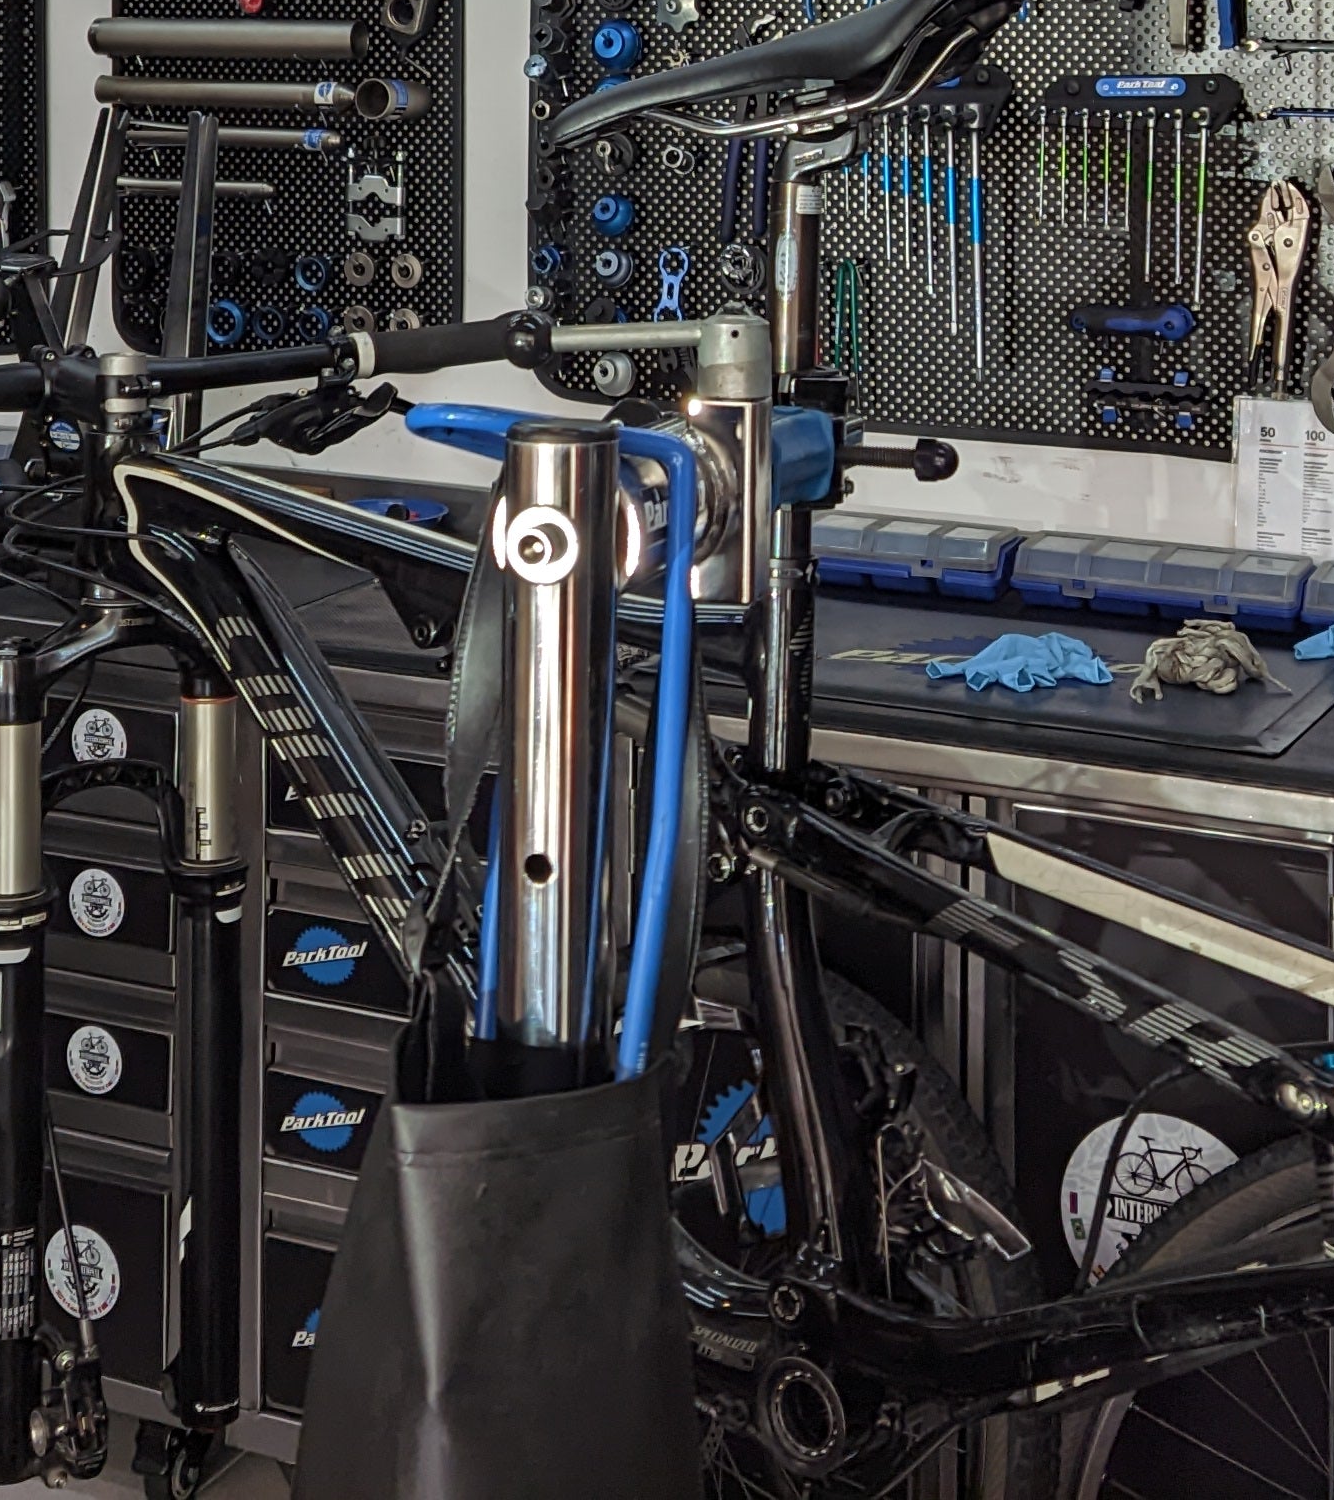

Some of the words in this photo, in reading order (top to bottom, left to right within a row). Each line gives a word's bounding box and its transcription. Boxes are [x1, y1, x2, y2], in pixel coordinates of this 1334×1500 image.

[1260, 426, 1276, 438] 50
[1305, 430, 1325, 442] 100
[282, 941, 367, 968] ParkTool
[280, 1106, 366, 1134] ParkTool
